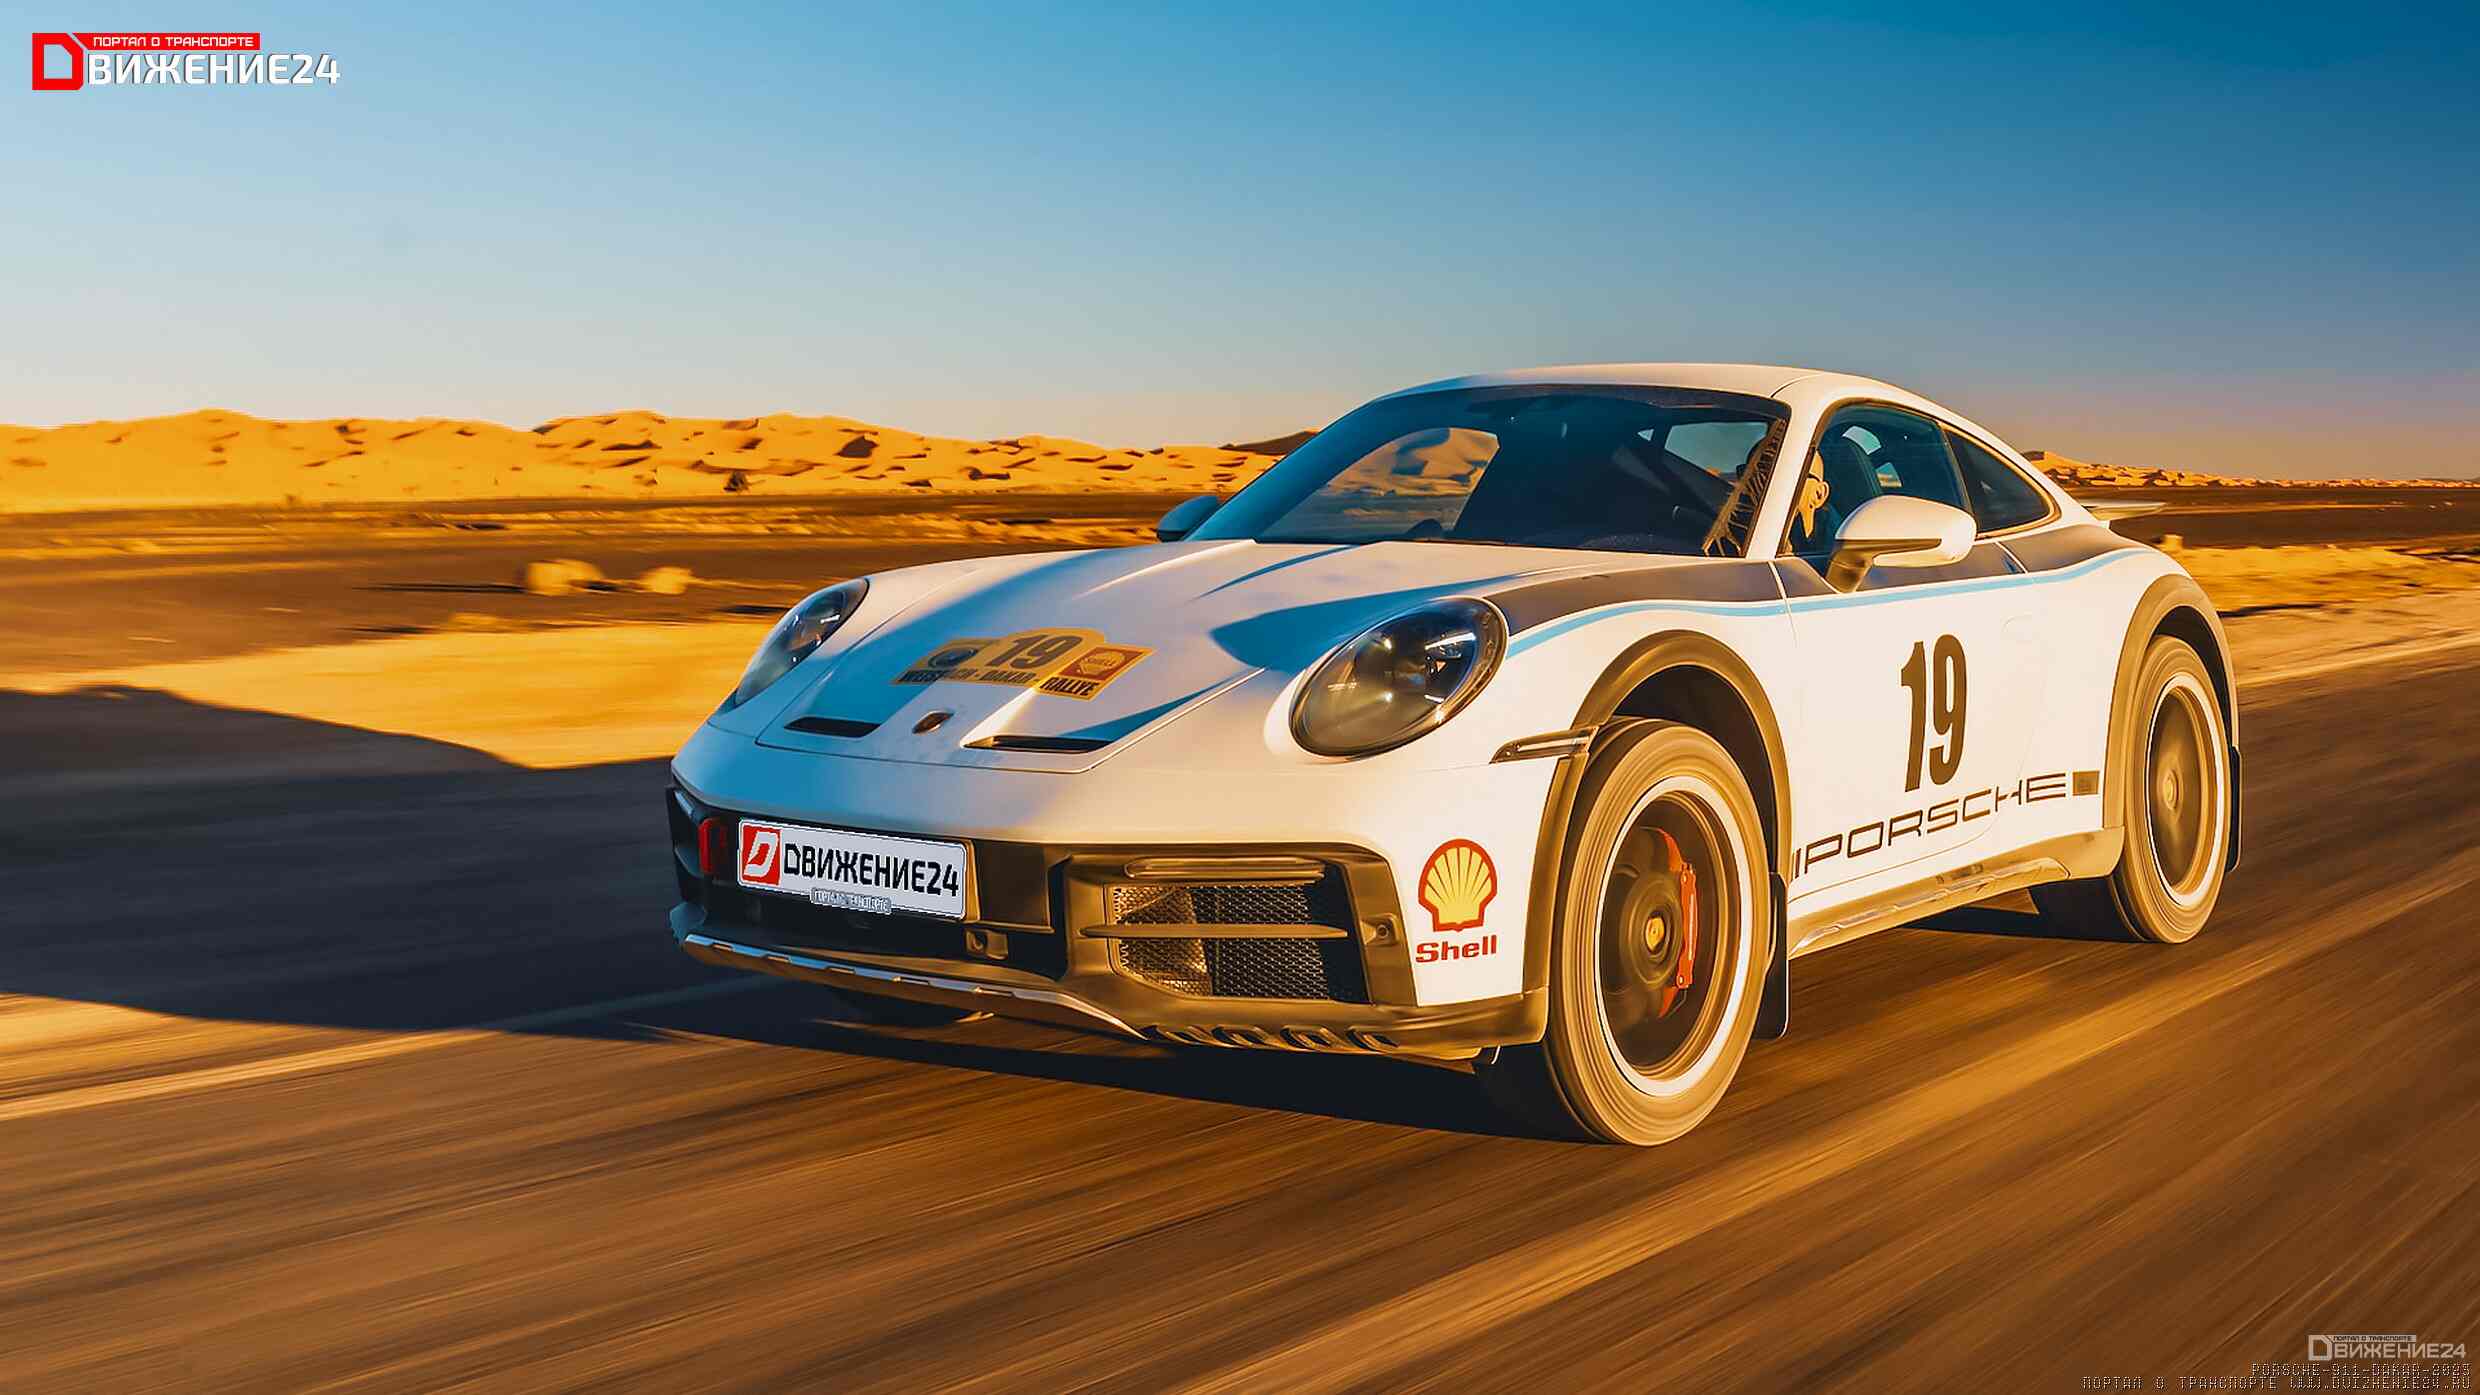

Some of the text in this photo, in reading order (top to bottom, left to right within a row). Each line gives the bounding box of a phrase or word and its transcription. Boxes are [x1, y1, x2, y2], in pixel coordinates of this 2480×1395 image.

[984, 634, 1084, 670] 19
[1040, 676, 1101, 697] RALLYE
[1900, 634, 1968, 792] 19
[1804, 772, 2067, 875] PORSCHE
[1415, 934, 1497, 963] Shell
